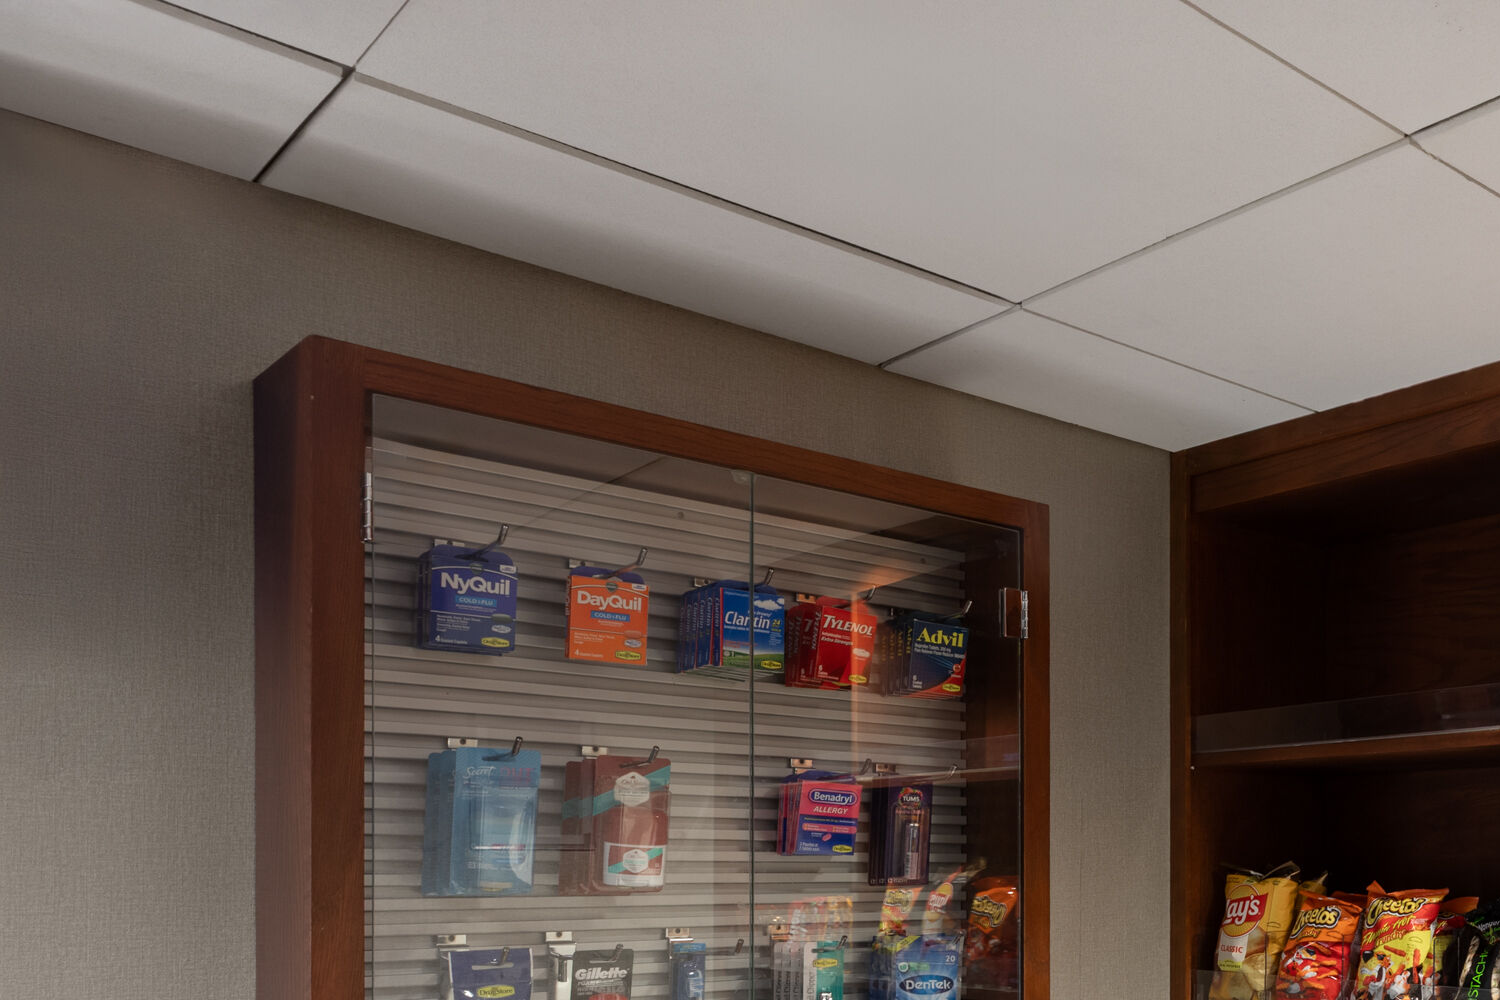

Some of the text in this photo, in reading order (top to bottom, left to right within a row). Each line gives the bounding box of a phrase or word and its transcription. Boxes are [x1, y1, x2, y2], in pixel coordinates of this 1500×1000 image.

[441, 572, 510, 596] NyQuil
[577, 590, 642, 611] DayQuil
[725, 611, 771, 630] Clartin
[823, 614, 873, 636] TYLENOL
[916, 627, 964, 648] Advil
[814, 791, 853, 805] Benadryl
[902, 793, 920, 802] TUMS
[813, 806, 849, 815] ALLERGY
[1366, 897, 1426, 928] Cheetos
[1220, 944, 1244, 954] CLASSIC
[575, 967, 628, 980] Gillette
[906, 979, 951, 990] DenTek
